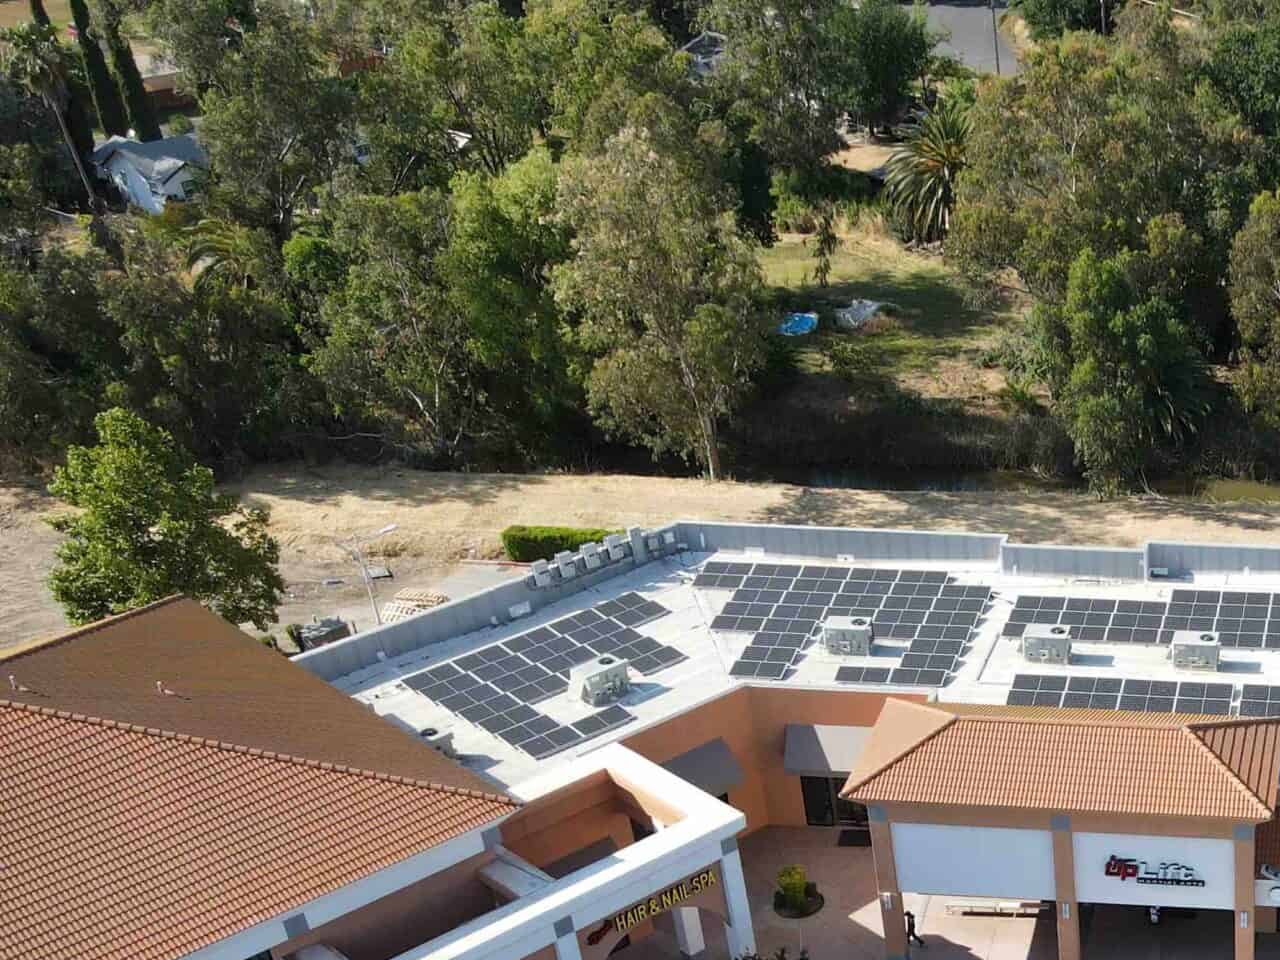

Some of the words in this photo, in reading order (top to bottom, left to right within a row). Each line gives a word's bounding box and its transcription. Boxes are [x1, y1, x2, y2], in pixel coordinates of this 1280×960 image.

[615, 904, 647, 933] HAIR
[649, 898, 661, 916] &
[662, 884, 691, 910] NAIL
[692, 871, 717, 894] SPA
